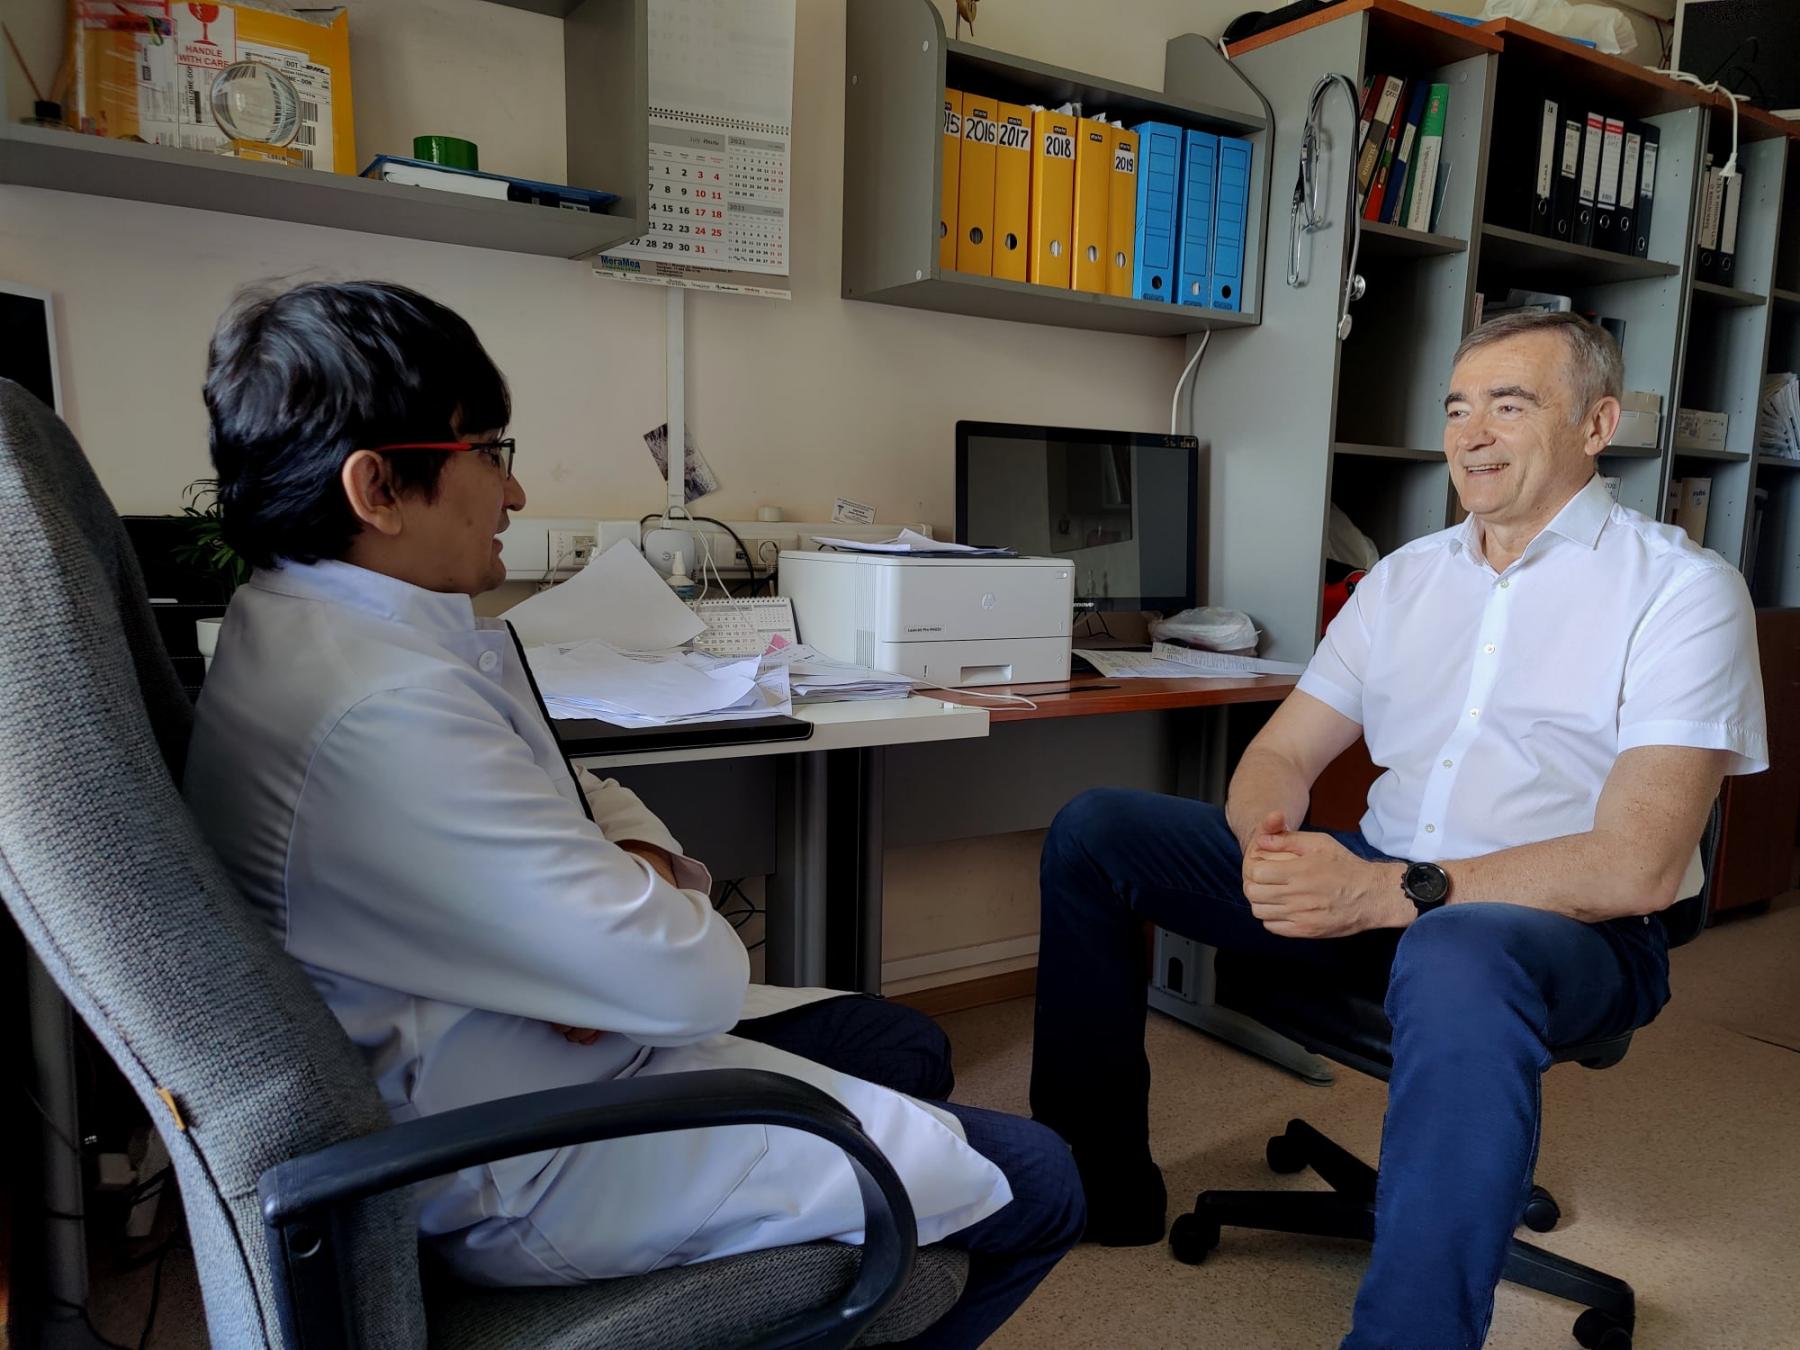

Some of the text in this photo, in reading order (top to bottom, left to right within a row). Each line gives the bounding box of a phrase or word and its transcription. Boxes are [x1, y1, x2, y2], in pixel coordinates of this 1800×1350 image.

[186, 45, 222, 58] HANDLE
[179, 54, 202, 64] WITH
[944, 112, 960, 134] 15
[966, 118, 996, 142] 2016
[999, 124, 1028, 148] 2017
[1046, 136, 1072, 158] 2018
[1116, 156, 1134, 172] 2019
[662, 205, 673, 213] 15
[662, 223, 673, 231] 22
[679, 225, 690, 233] 23
[695, 227, 706, 235] 24
[646, 240, 657, 248] 28
[662, 242, 673, 250] 29
